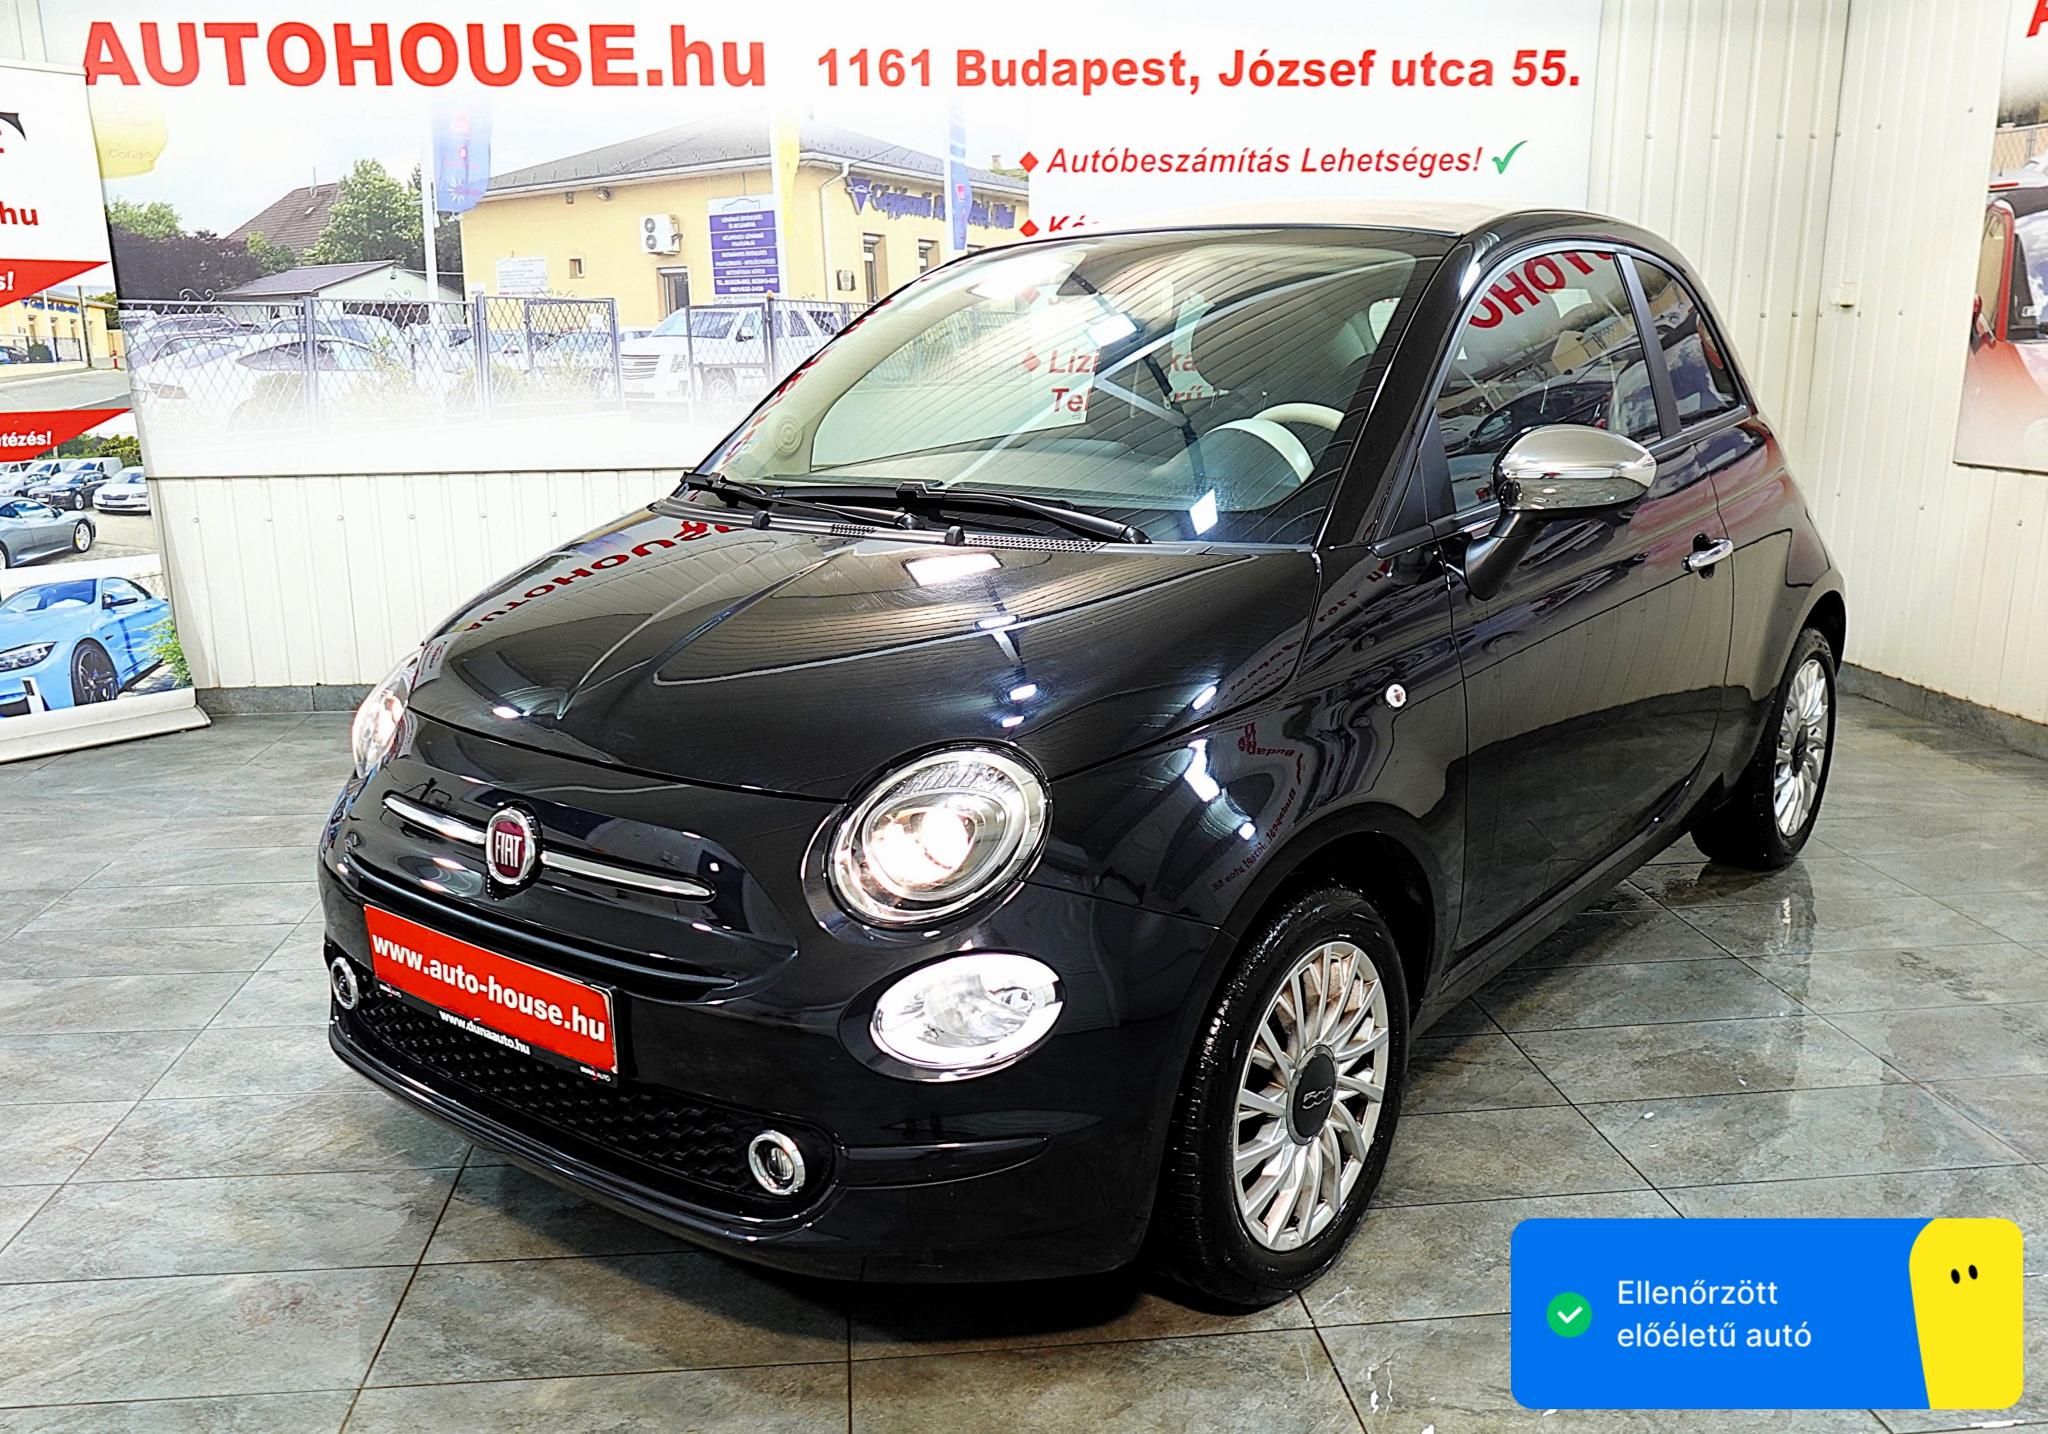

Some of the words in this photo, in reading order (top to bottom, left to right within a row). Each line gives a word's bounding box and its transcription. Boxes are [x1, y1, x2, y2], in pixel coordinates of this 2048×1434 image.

[83, 20, 766, 88] AUTOHOUSE.hu
[817, 47, 931, 88] 1161
[956, 48, 1200, 97] Budapest,
[1218, 48, 1377, 88] József
[1391, 51, 1494, 88] utca
[1511, 49, 1580, 88] 55.
[1046, 147, 1290, 174] Autóbeszámítás
[1300, 146, 1483, 179] Lehetséges!
[494, 829, 524, 869] FIAT
[371, 933, 607, 1043] www.auto-house.hu
[438, 1009, 532, 1056] www.dunaauto.hu
[1301, 1085, 1333, 1110] 500
